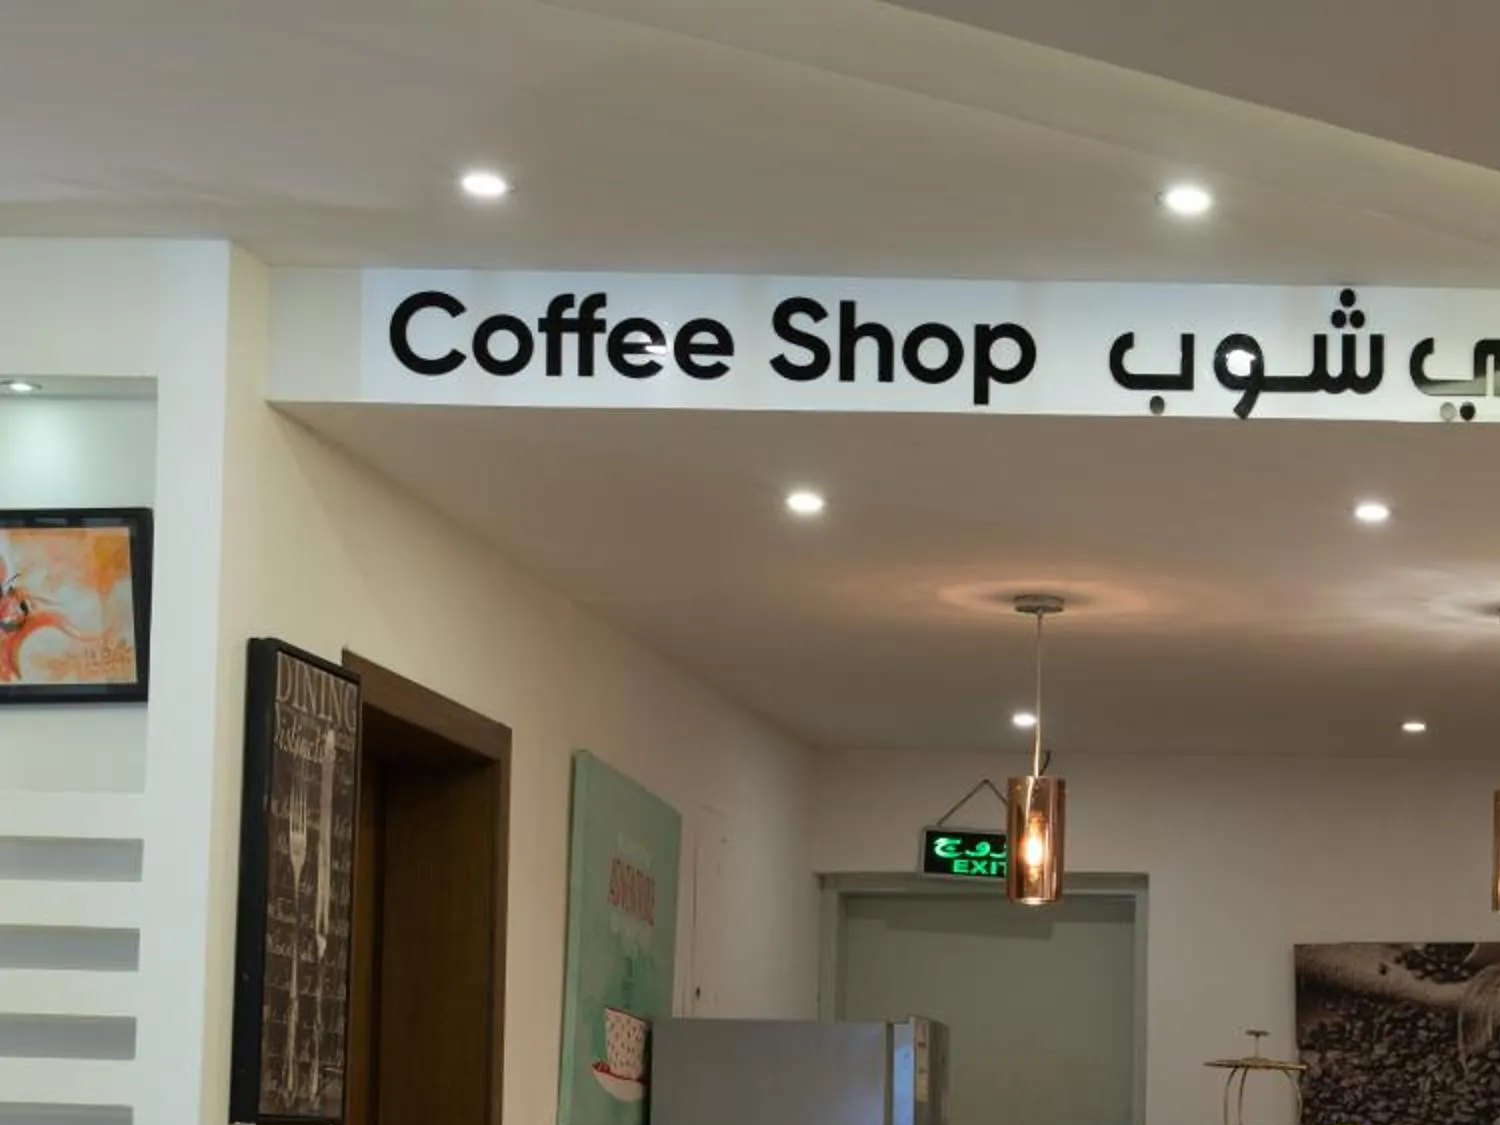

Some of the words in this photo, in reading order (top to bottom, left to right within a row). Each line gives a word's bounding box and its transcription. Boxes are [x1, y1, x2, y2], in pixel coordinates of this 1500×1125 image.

[388, 290, 735, 381] Coffee
[768, 296, 1037, 406] Shop
[1108, 287, 1385, 420] شوب
[275, 651, 359, 735] DINING
